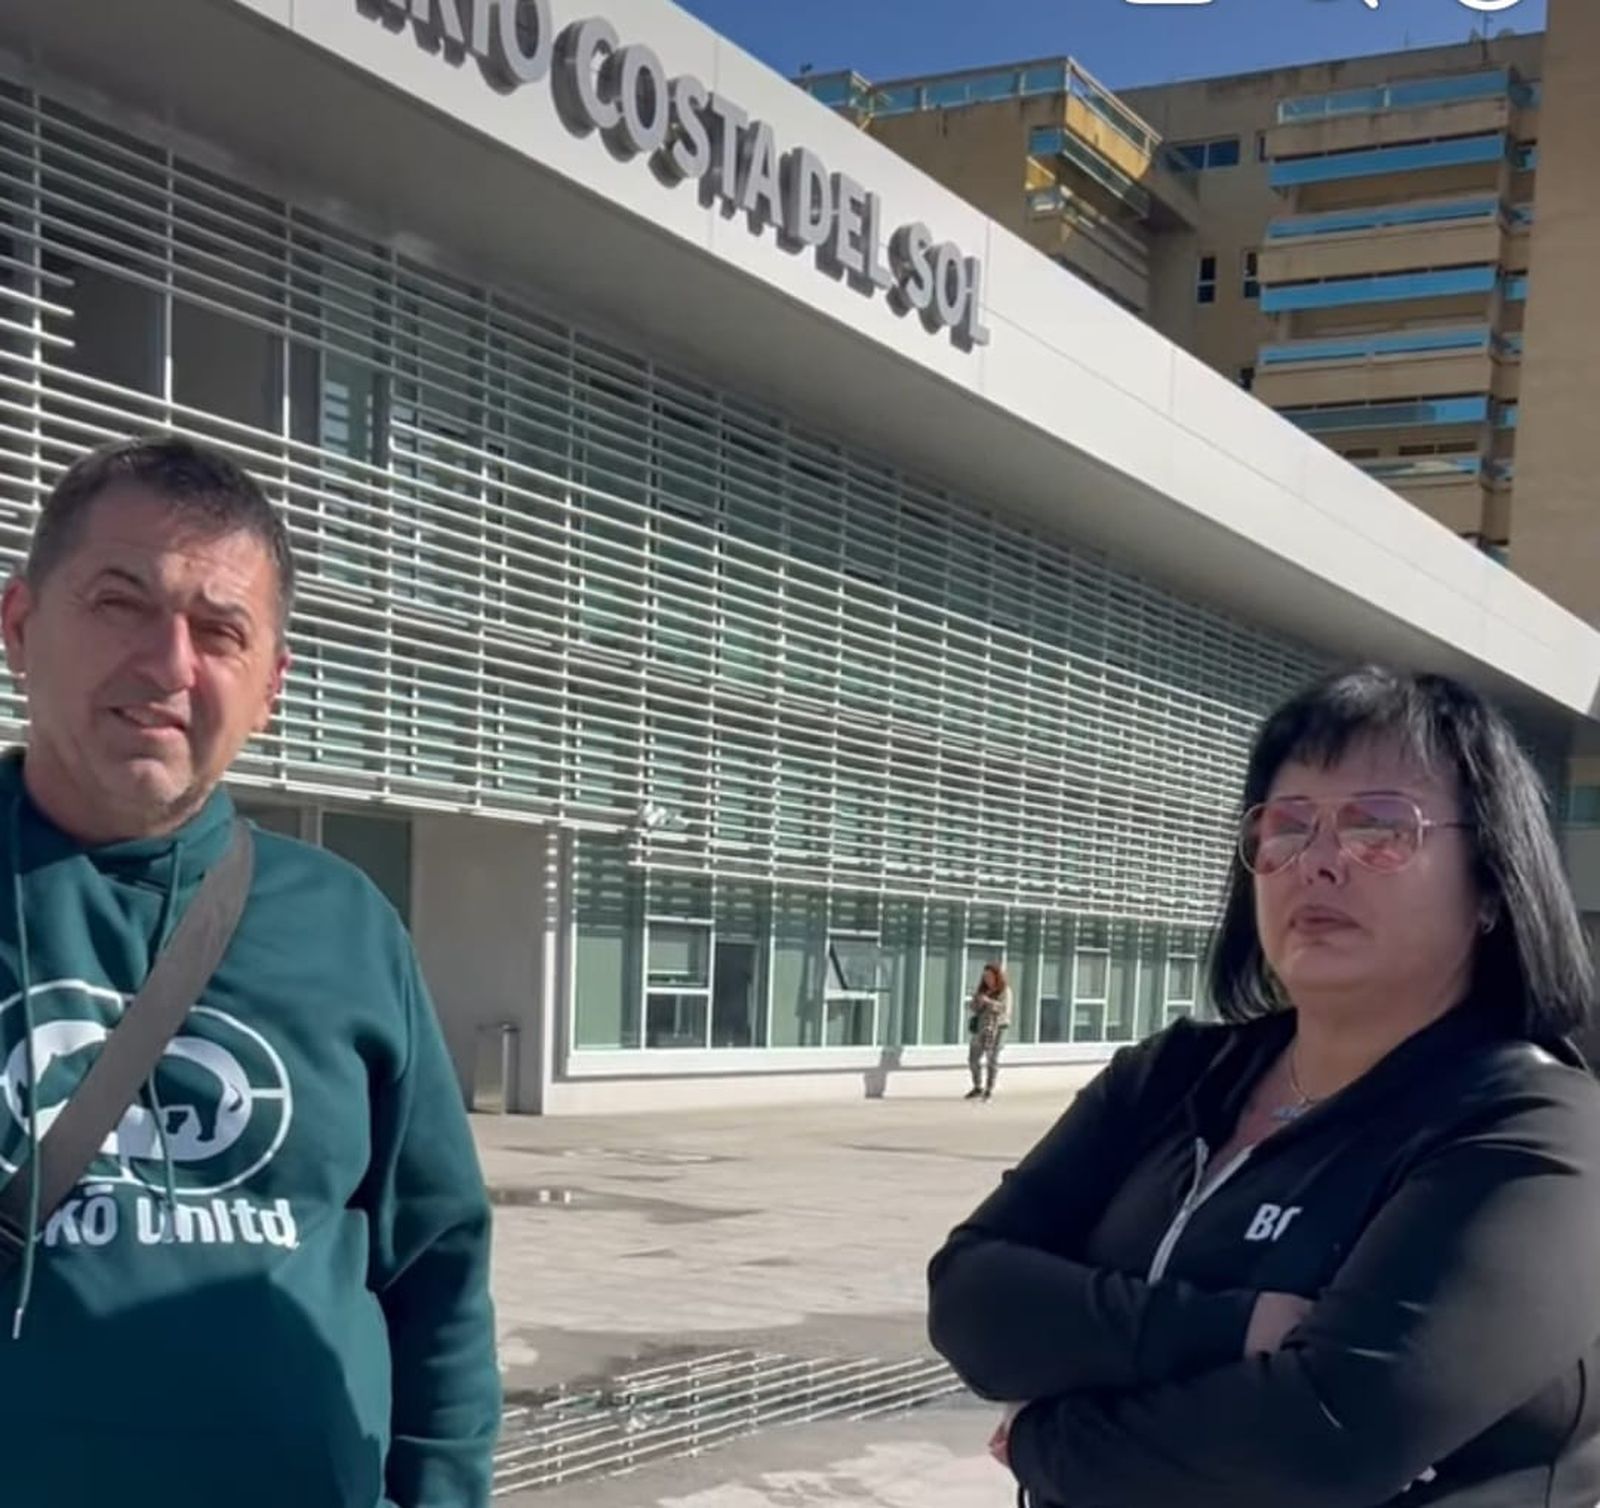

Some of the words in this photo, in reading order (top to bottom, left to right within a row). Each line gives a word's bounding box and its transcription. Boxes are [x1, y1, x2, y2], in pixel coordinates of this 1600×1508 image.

[551, 16, 783, 236] COSTA
[776, 147, 891, 298] DEL
[886, 221, 989, 353] SOL
